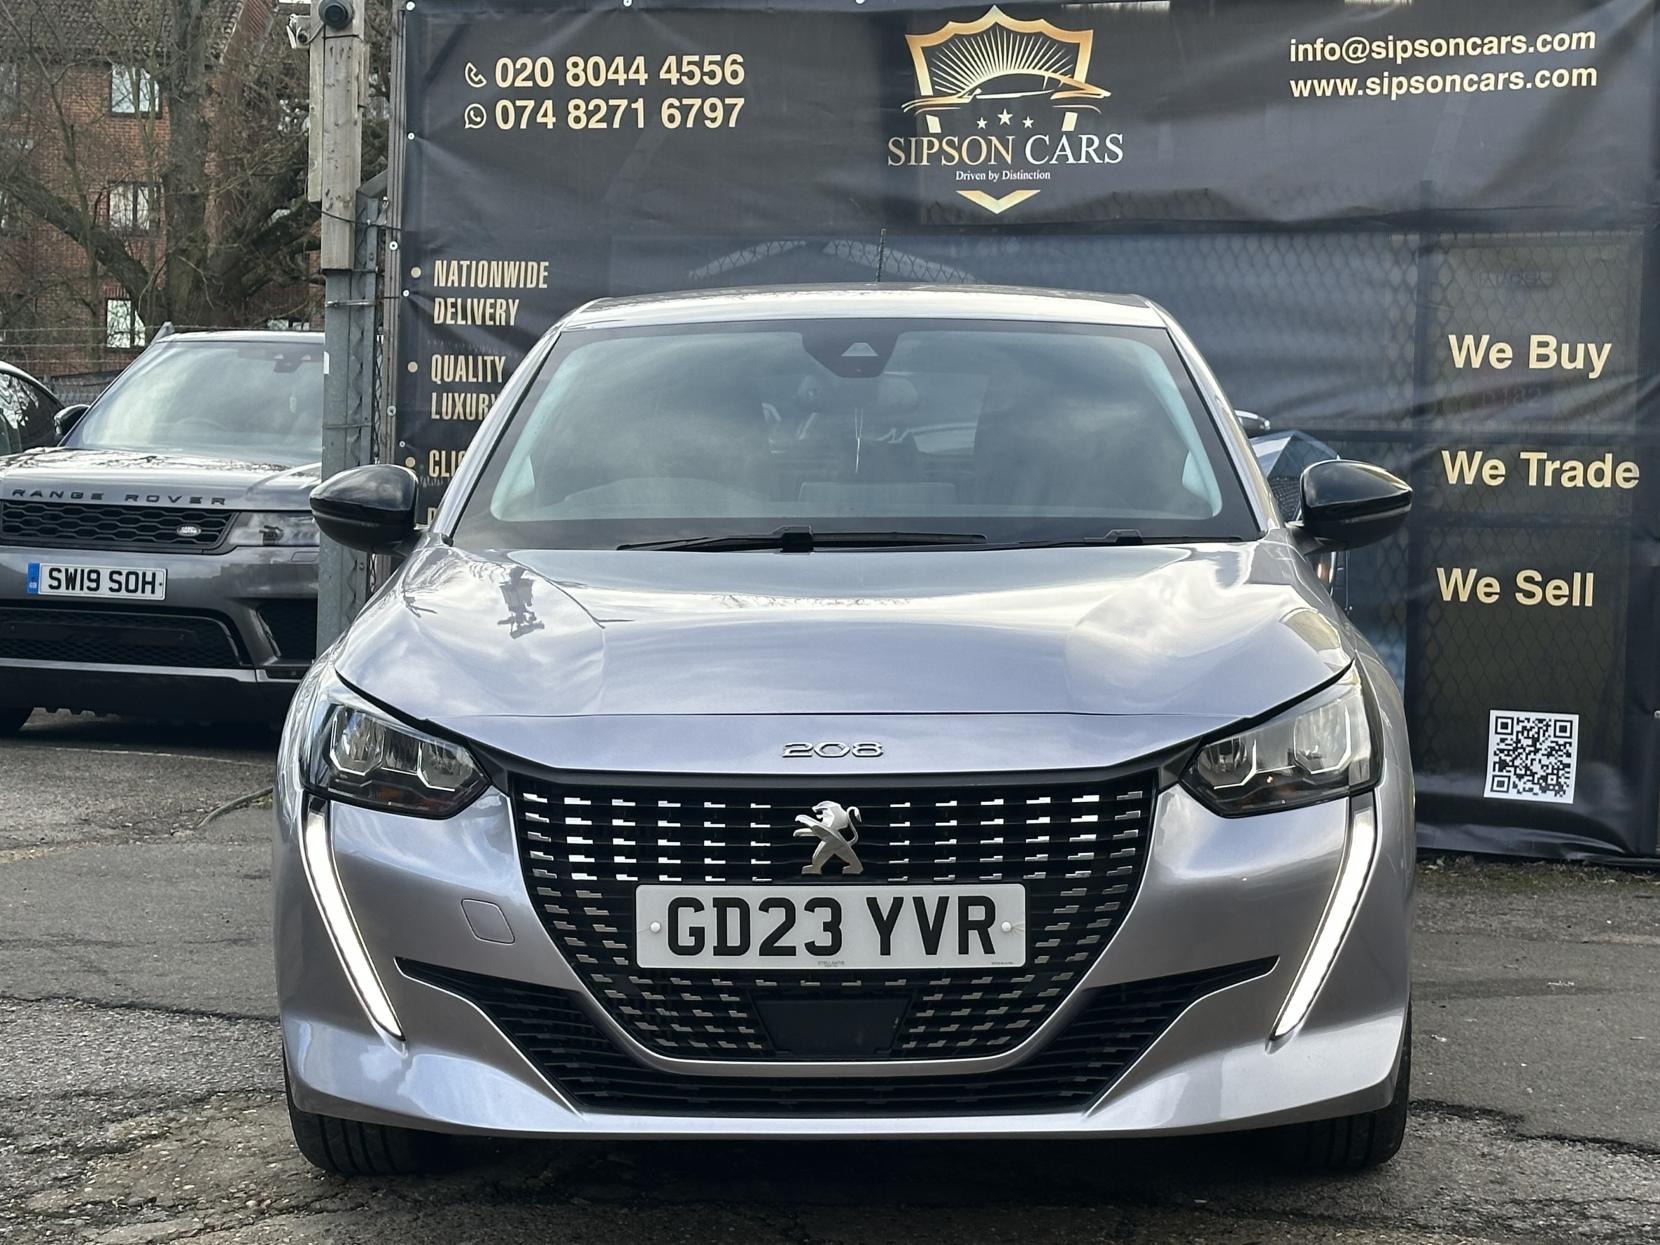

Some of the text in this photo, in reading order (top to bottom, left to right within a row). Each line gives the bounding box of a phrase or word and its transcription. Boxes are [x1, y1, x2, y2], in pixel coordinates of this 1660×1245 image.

[1290, 30, 1596, 64] info@sipsoncars.com
[495, 54, 745, 88] 020 8044 4556
[1289, 67, 1598, 100] www.sipsoncars.com
[495, 97, 746, 130] 074 8271 6797
[887, 133, 1124, 167] SIPSON CARS
[955, 169, 1051, 183] Driven by Distinction
[433, 260, 549, 289] NATIONWIDE
[433, 297, 520, 326] DELIVERY
[431, 354, 506, 385] QUALITY
[1448, 334, 1613, 379] We Buy
[1441, 450, 1640, 489] We Trade
[12, 489, 226, 506] RANGE ROVER
[48, 567, 156, 594] SW19 SOH
[1436, 567, 1594, 607] We Sell
[782, 742, 883, 758] 208
[667, 895, 996, 957] GD23 YVR
